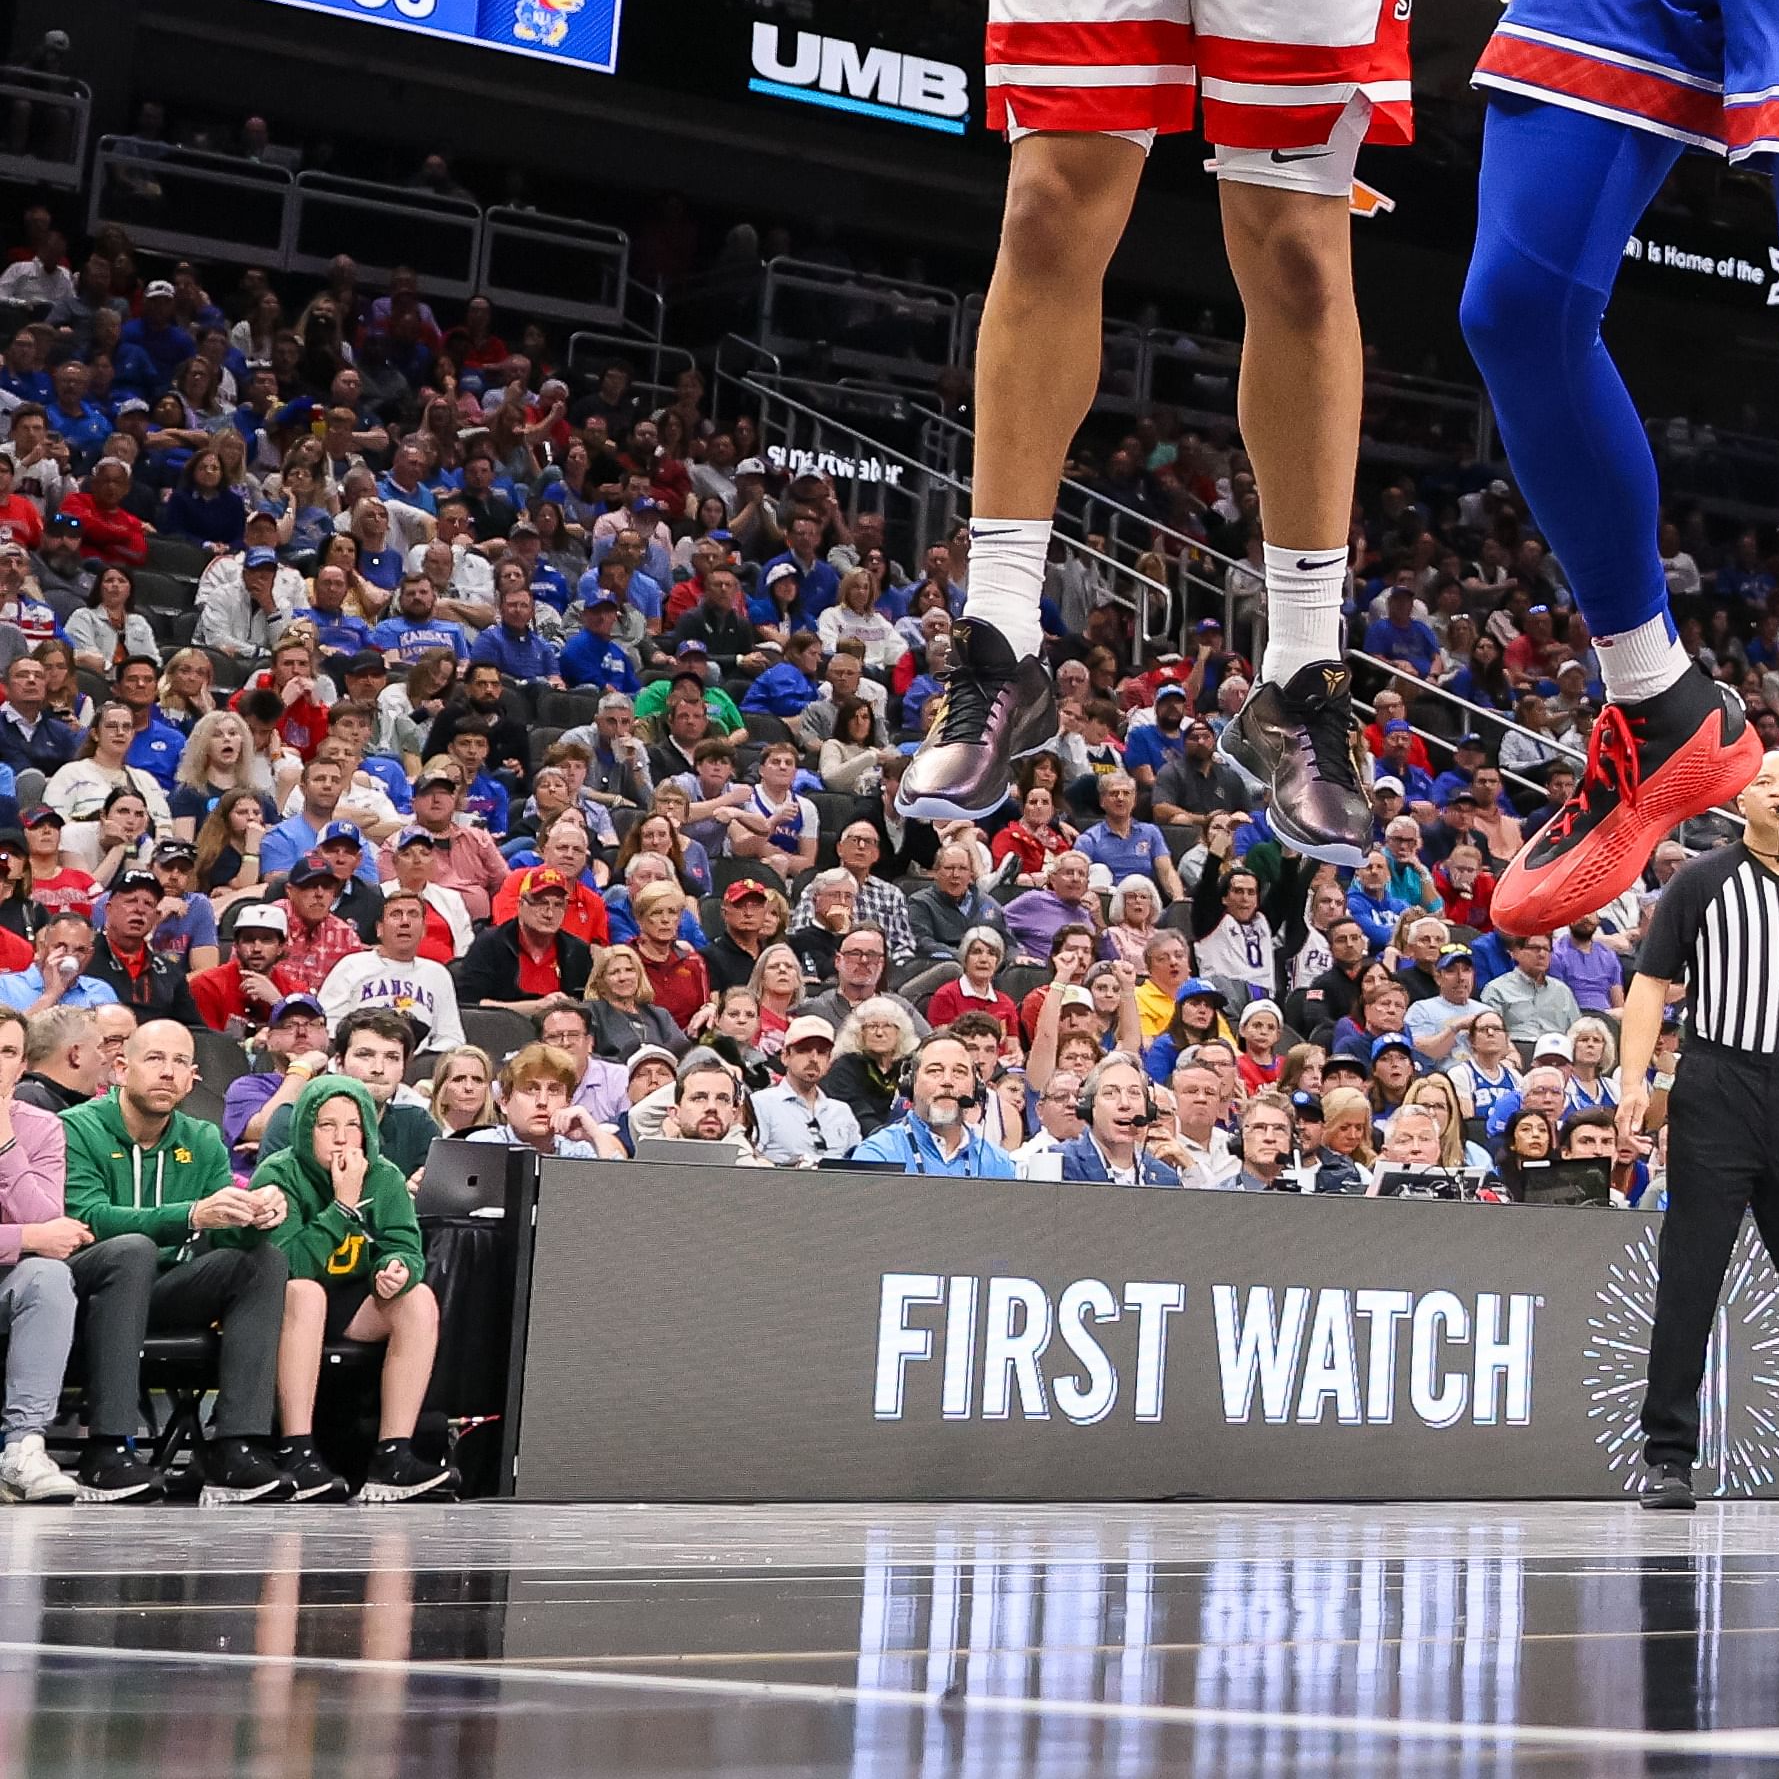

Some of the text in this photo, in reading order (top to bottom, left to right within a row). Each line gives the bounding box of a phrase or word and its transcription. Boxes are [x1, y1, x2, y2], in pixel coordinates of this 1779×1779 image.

[751, 21, 970, 117] UMB
[1647, 240, 1661, 263] is
[1664, 244, 1715, 274] Home
[1717, 257, 1736, 278] of
[1737, 259, 1765, 285] the
[873, 1272, 1532, 1428] FIRST WATCH
